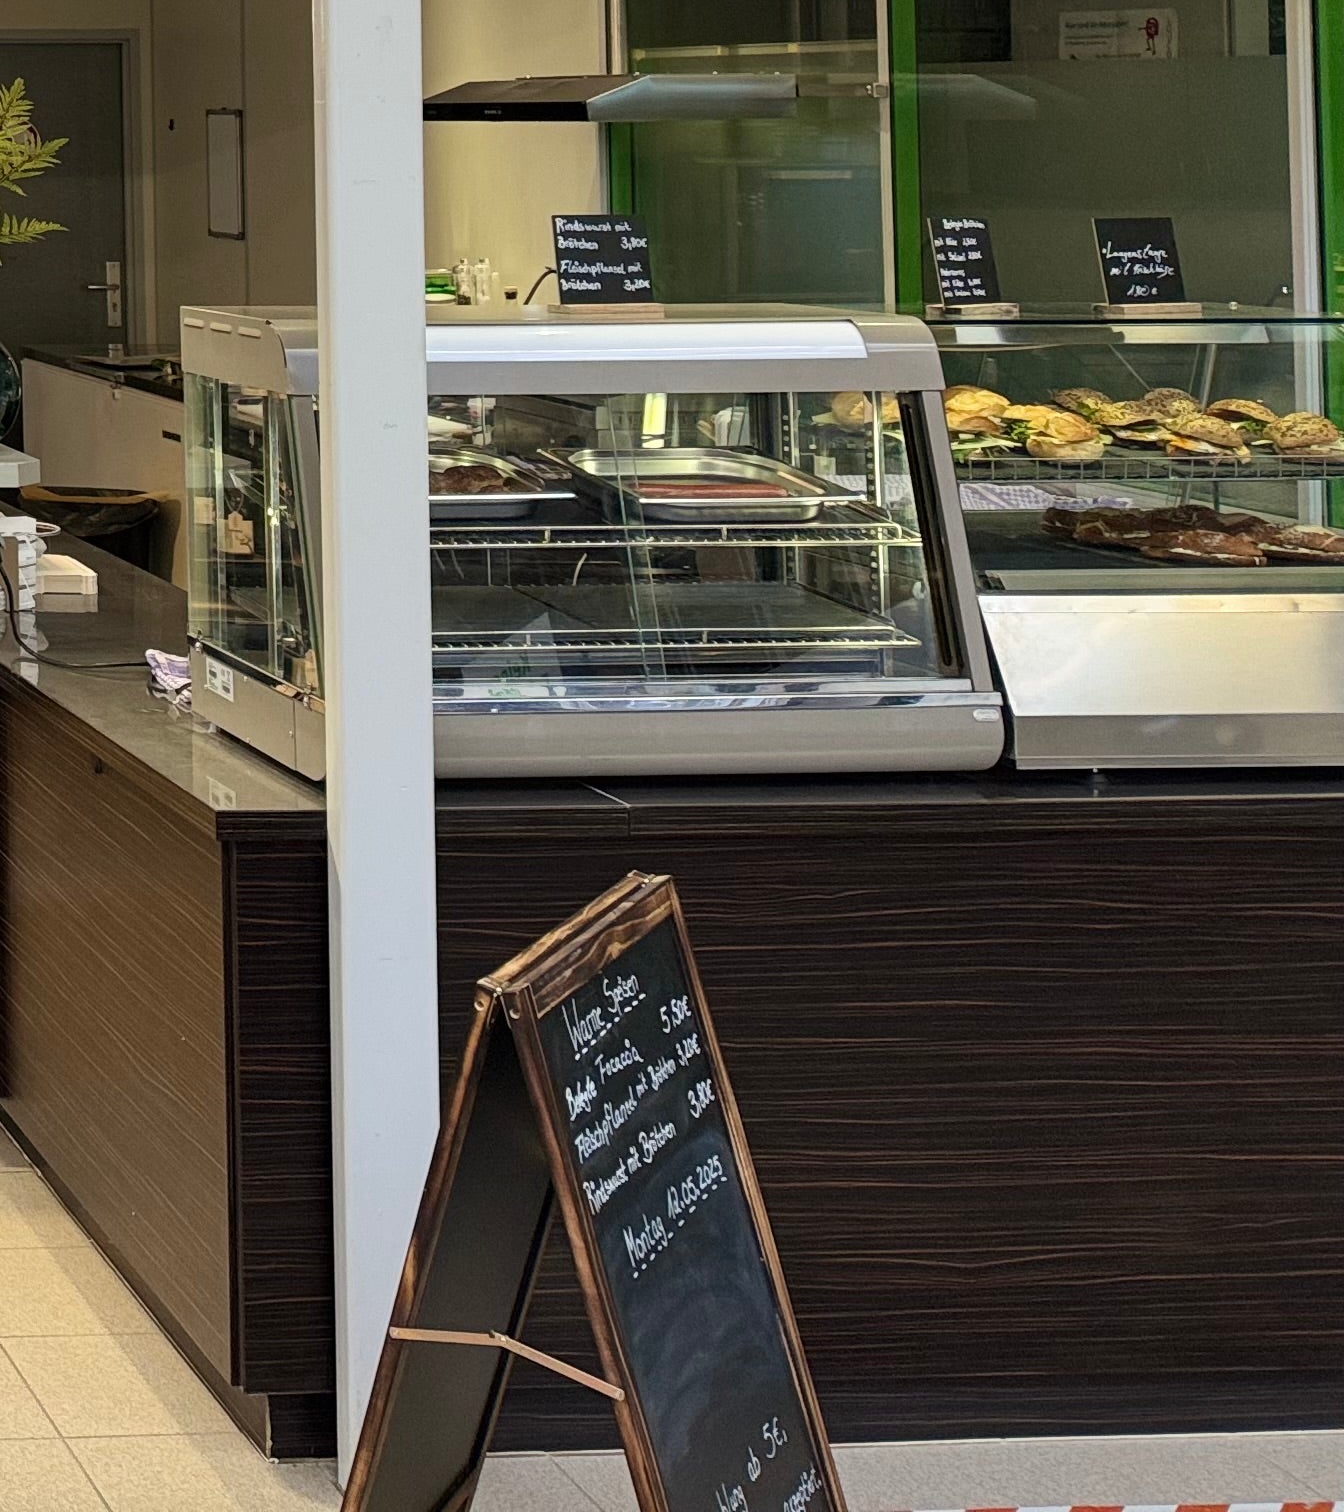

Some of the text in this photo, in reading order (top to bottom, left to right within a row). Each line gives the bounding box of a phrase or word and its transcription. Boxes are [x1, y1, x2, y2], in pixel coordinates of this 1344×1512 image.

[557, 235, 648, 251] Brötchen 3,80€
[614, 221, 633, 232] mit
[562, 997, 606, 1052] Warme
[622, 1154, 724, 1268] Montag 12.05.2025
[747, 1445, 761, 1482] ab
